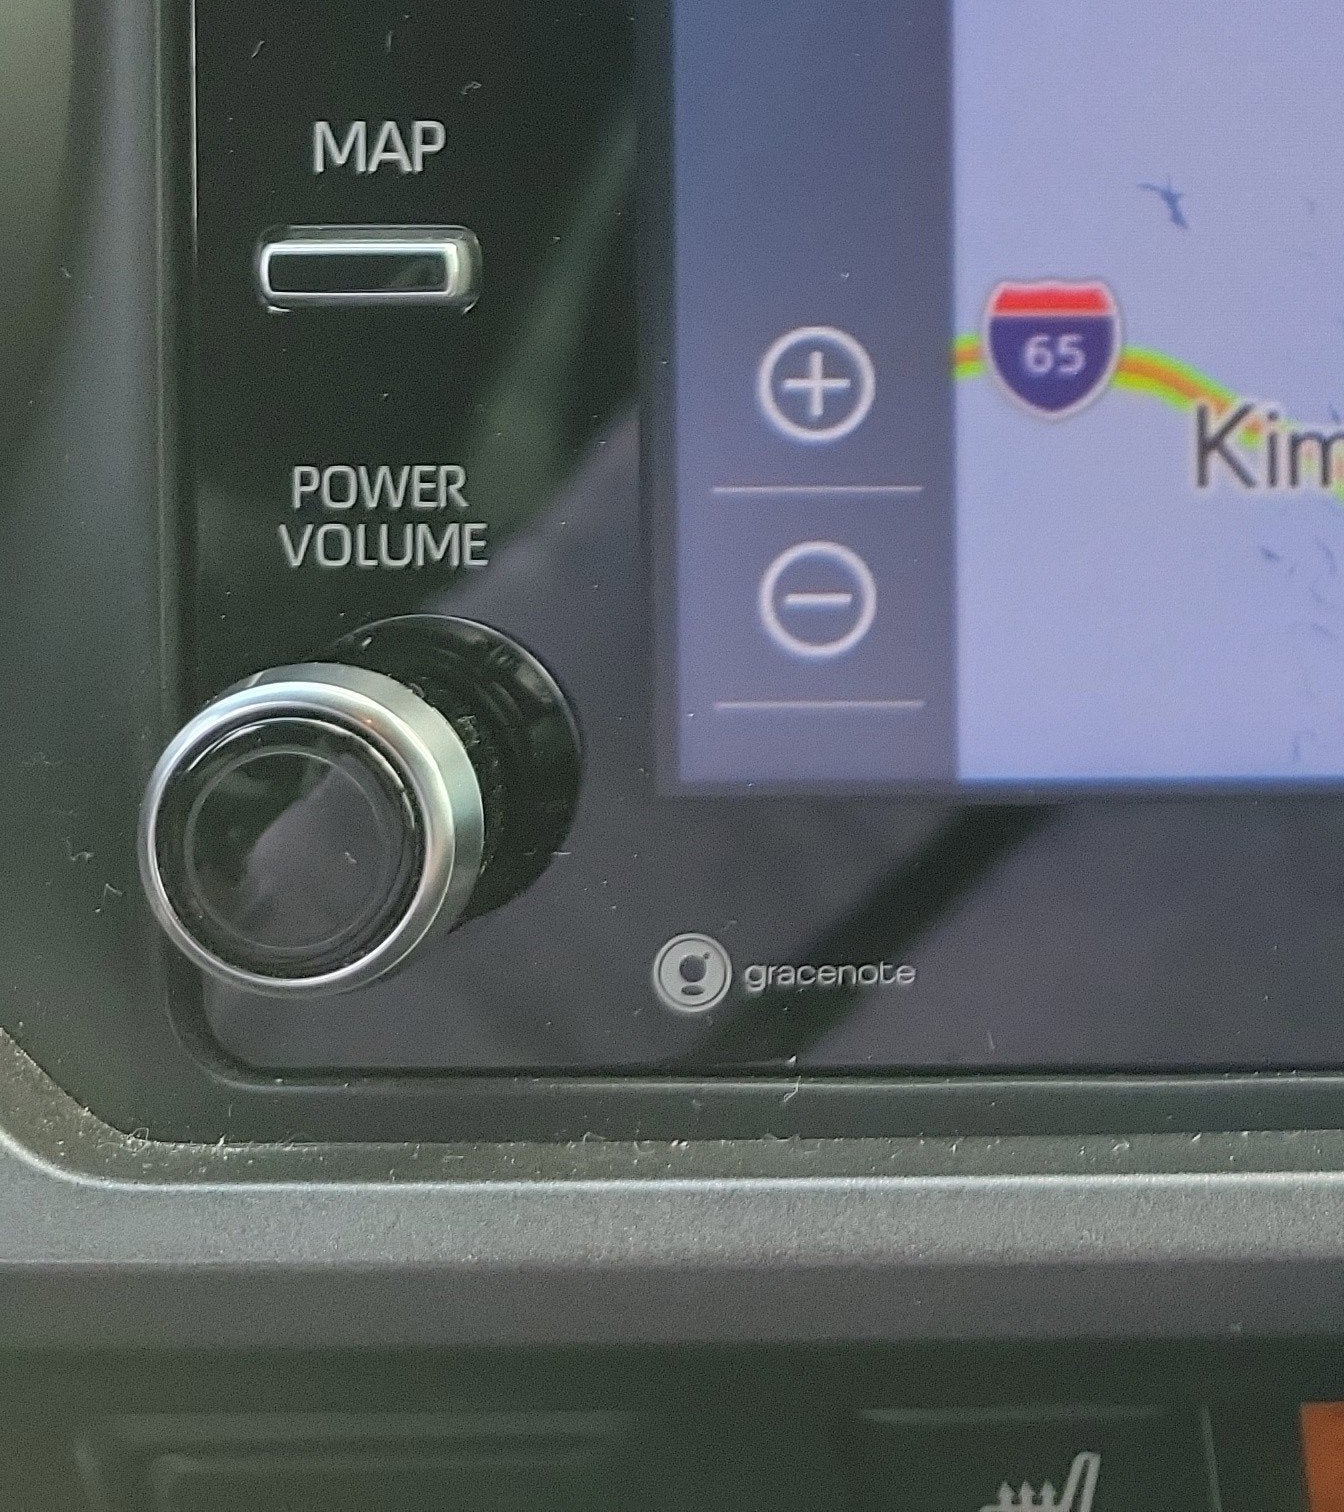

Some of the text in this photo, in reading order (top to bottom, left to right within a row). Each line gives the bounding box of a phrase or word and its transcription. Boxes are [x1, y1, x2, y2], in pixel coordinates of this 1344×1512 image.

[311, 119, 447, 174] MAP
[1022, 334, 1087, 374] 65
[290, 464, 470, 510] POWER
[278, 522, 489, 568] VOLUME
[744, 962, 917, 991] gracenote
